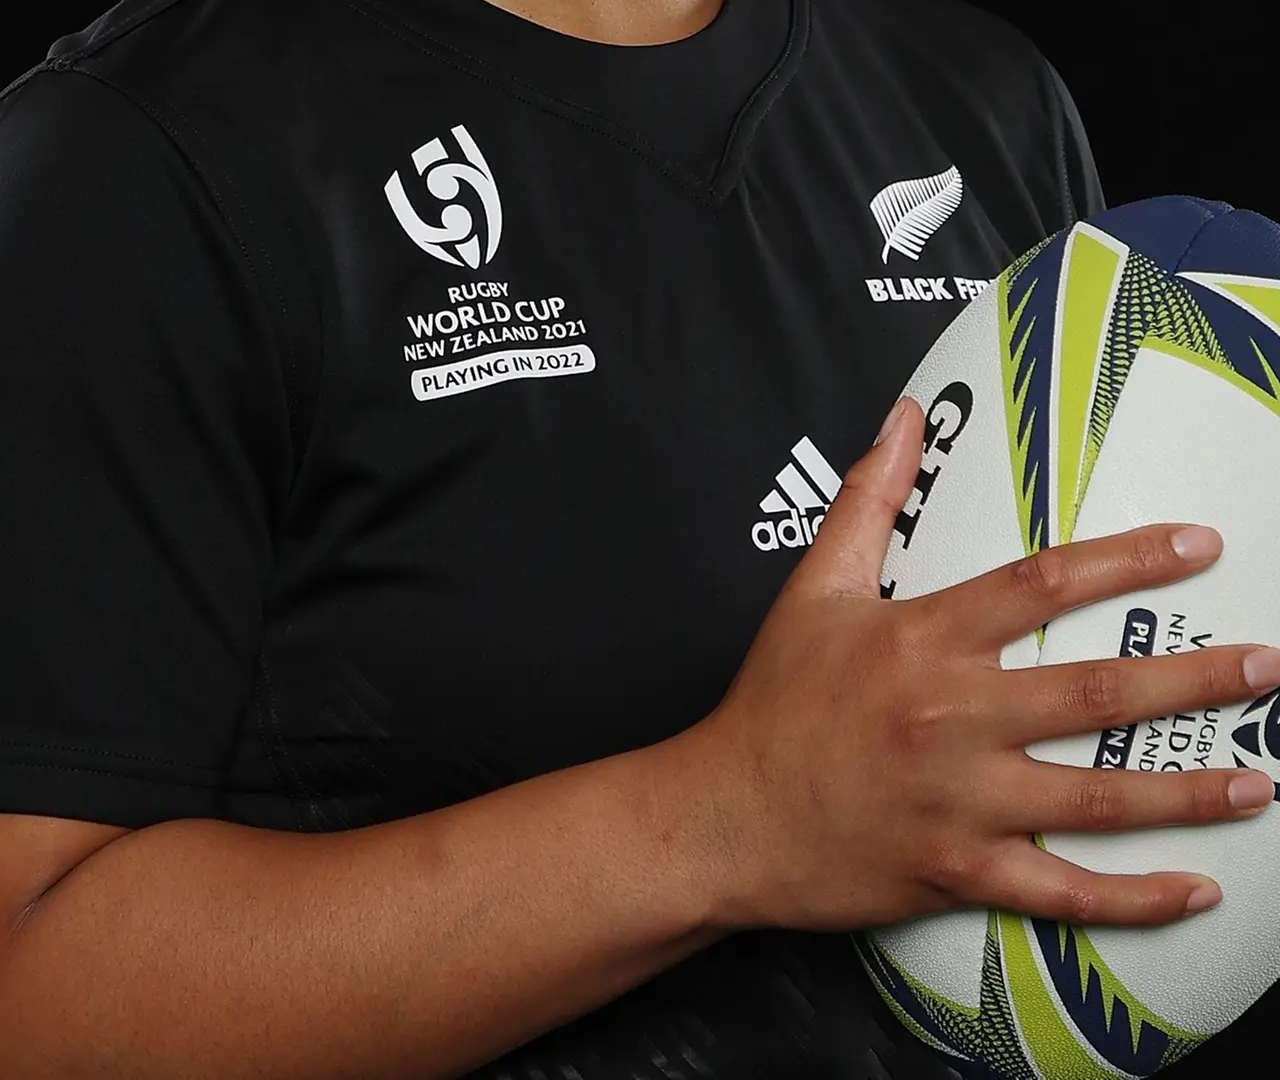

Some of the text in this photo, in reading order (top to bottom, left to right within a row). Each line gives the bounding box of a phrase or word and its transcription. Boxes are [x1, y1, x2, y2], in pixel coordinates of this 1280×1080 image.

[447, 282, 509, 304] RUGBY
[864, 277, 954, 302] BLACK
[407, 297, 565, 339] WORLD CUP
[403, 320, 587, 362] NEW ZEALAND 2021
[421, 352, 585, 393] PLAYING IN 2022
[751, 508, 825, 552] adi
[1139, 717, 1167, 771] LAND
[1193, 708, 1221, 768] UGBY
